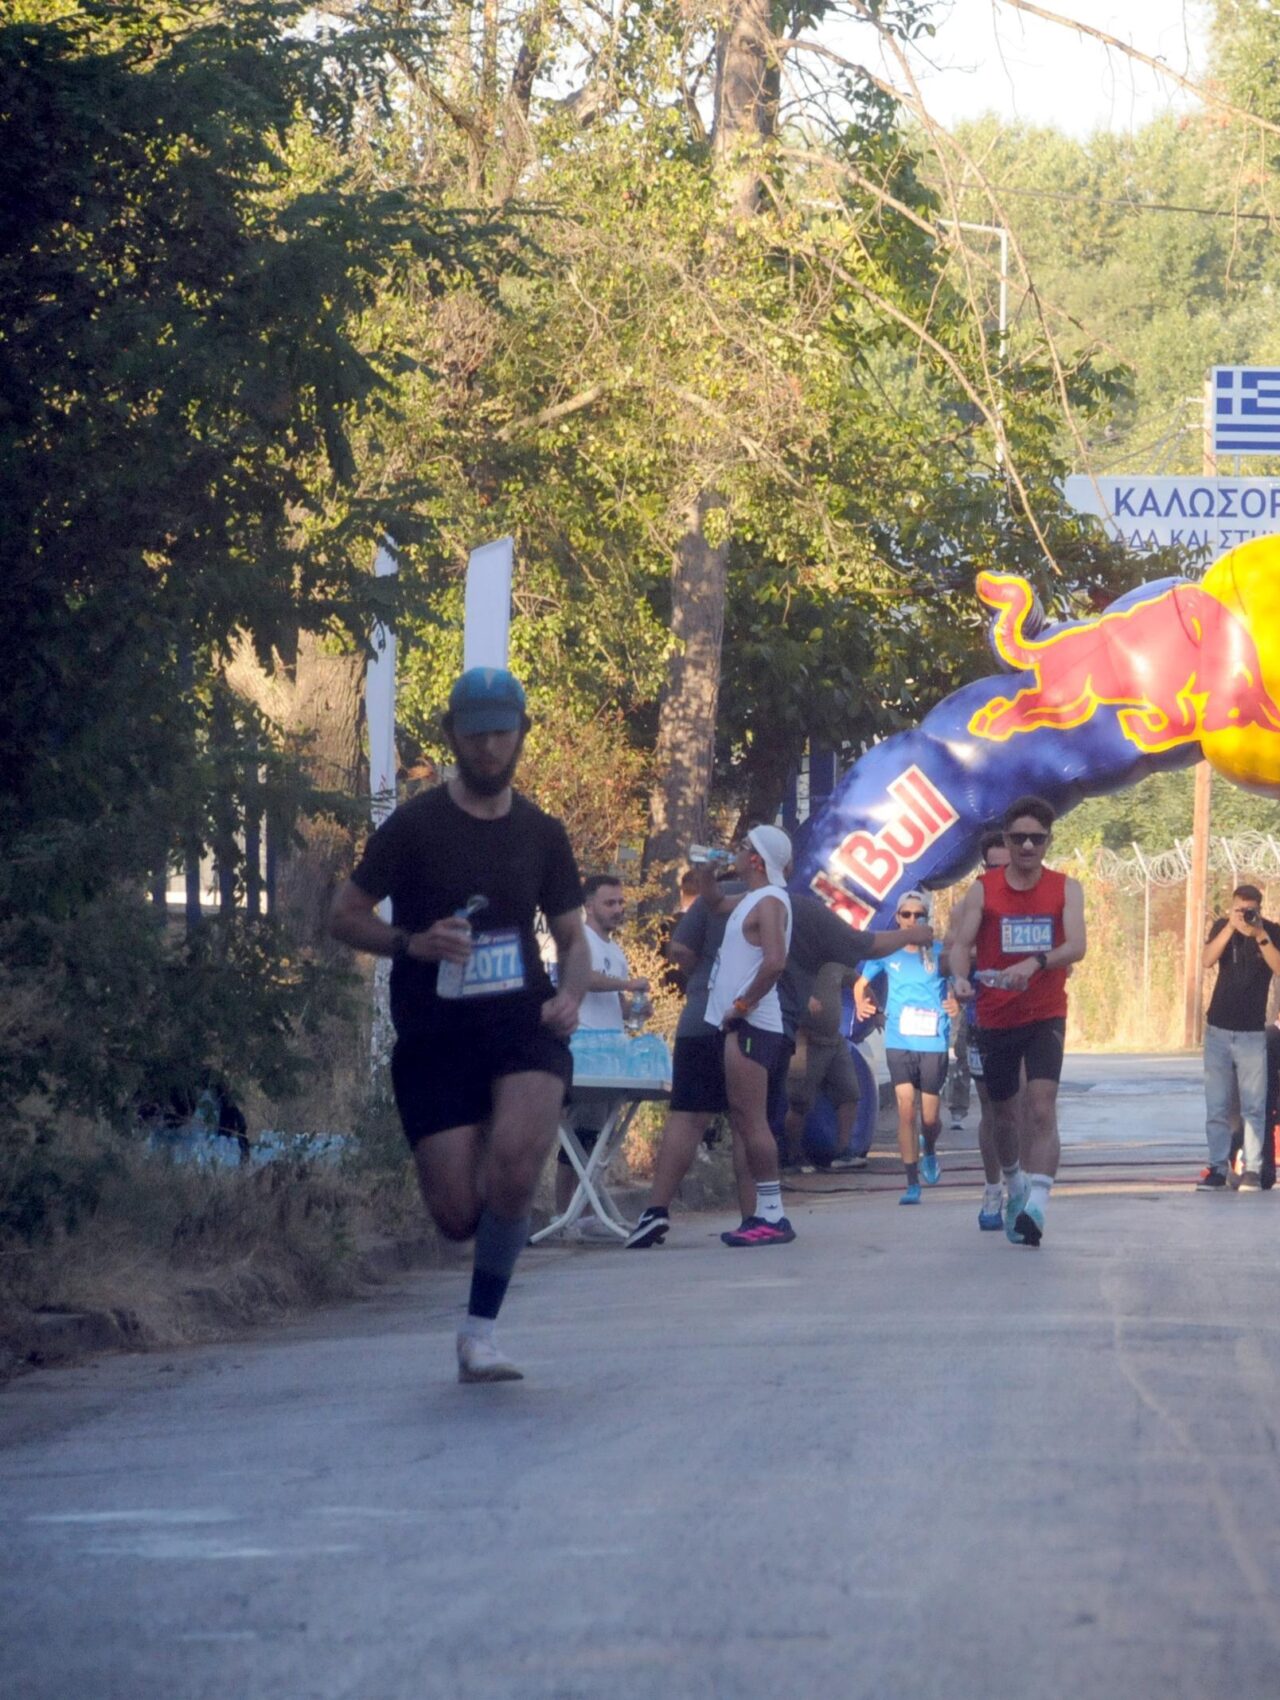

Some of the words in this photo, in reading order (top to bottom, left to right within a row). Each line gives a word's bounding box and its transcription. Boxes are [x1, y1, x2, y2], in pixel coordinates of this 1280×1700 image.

[1171, 529, 1208, 549] ΚΑΙ
[831, 766, 957, 898] Bull
[1013, 926, 1051, 944] 2104
[464, 944, 519, 981] 2077
